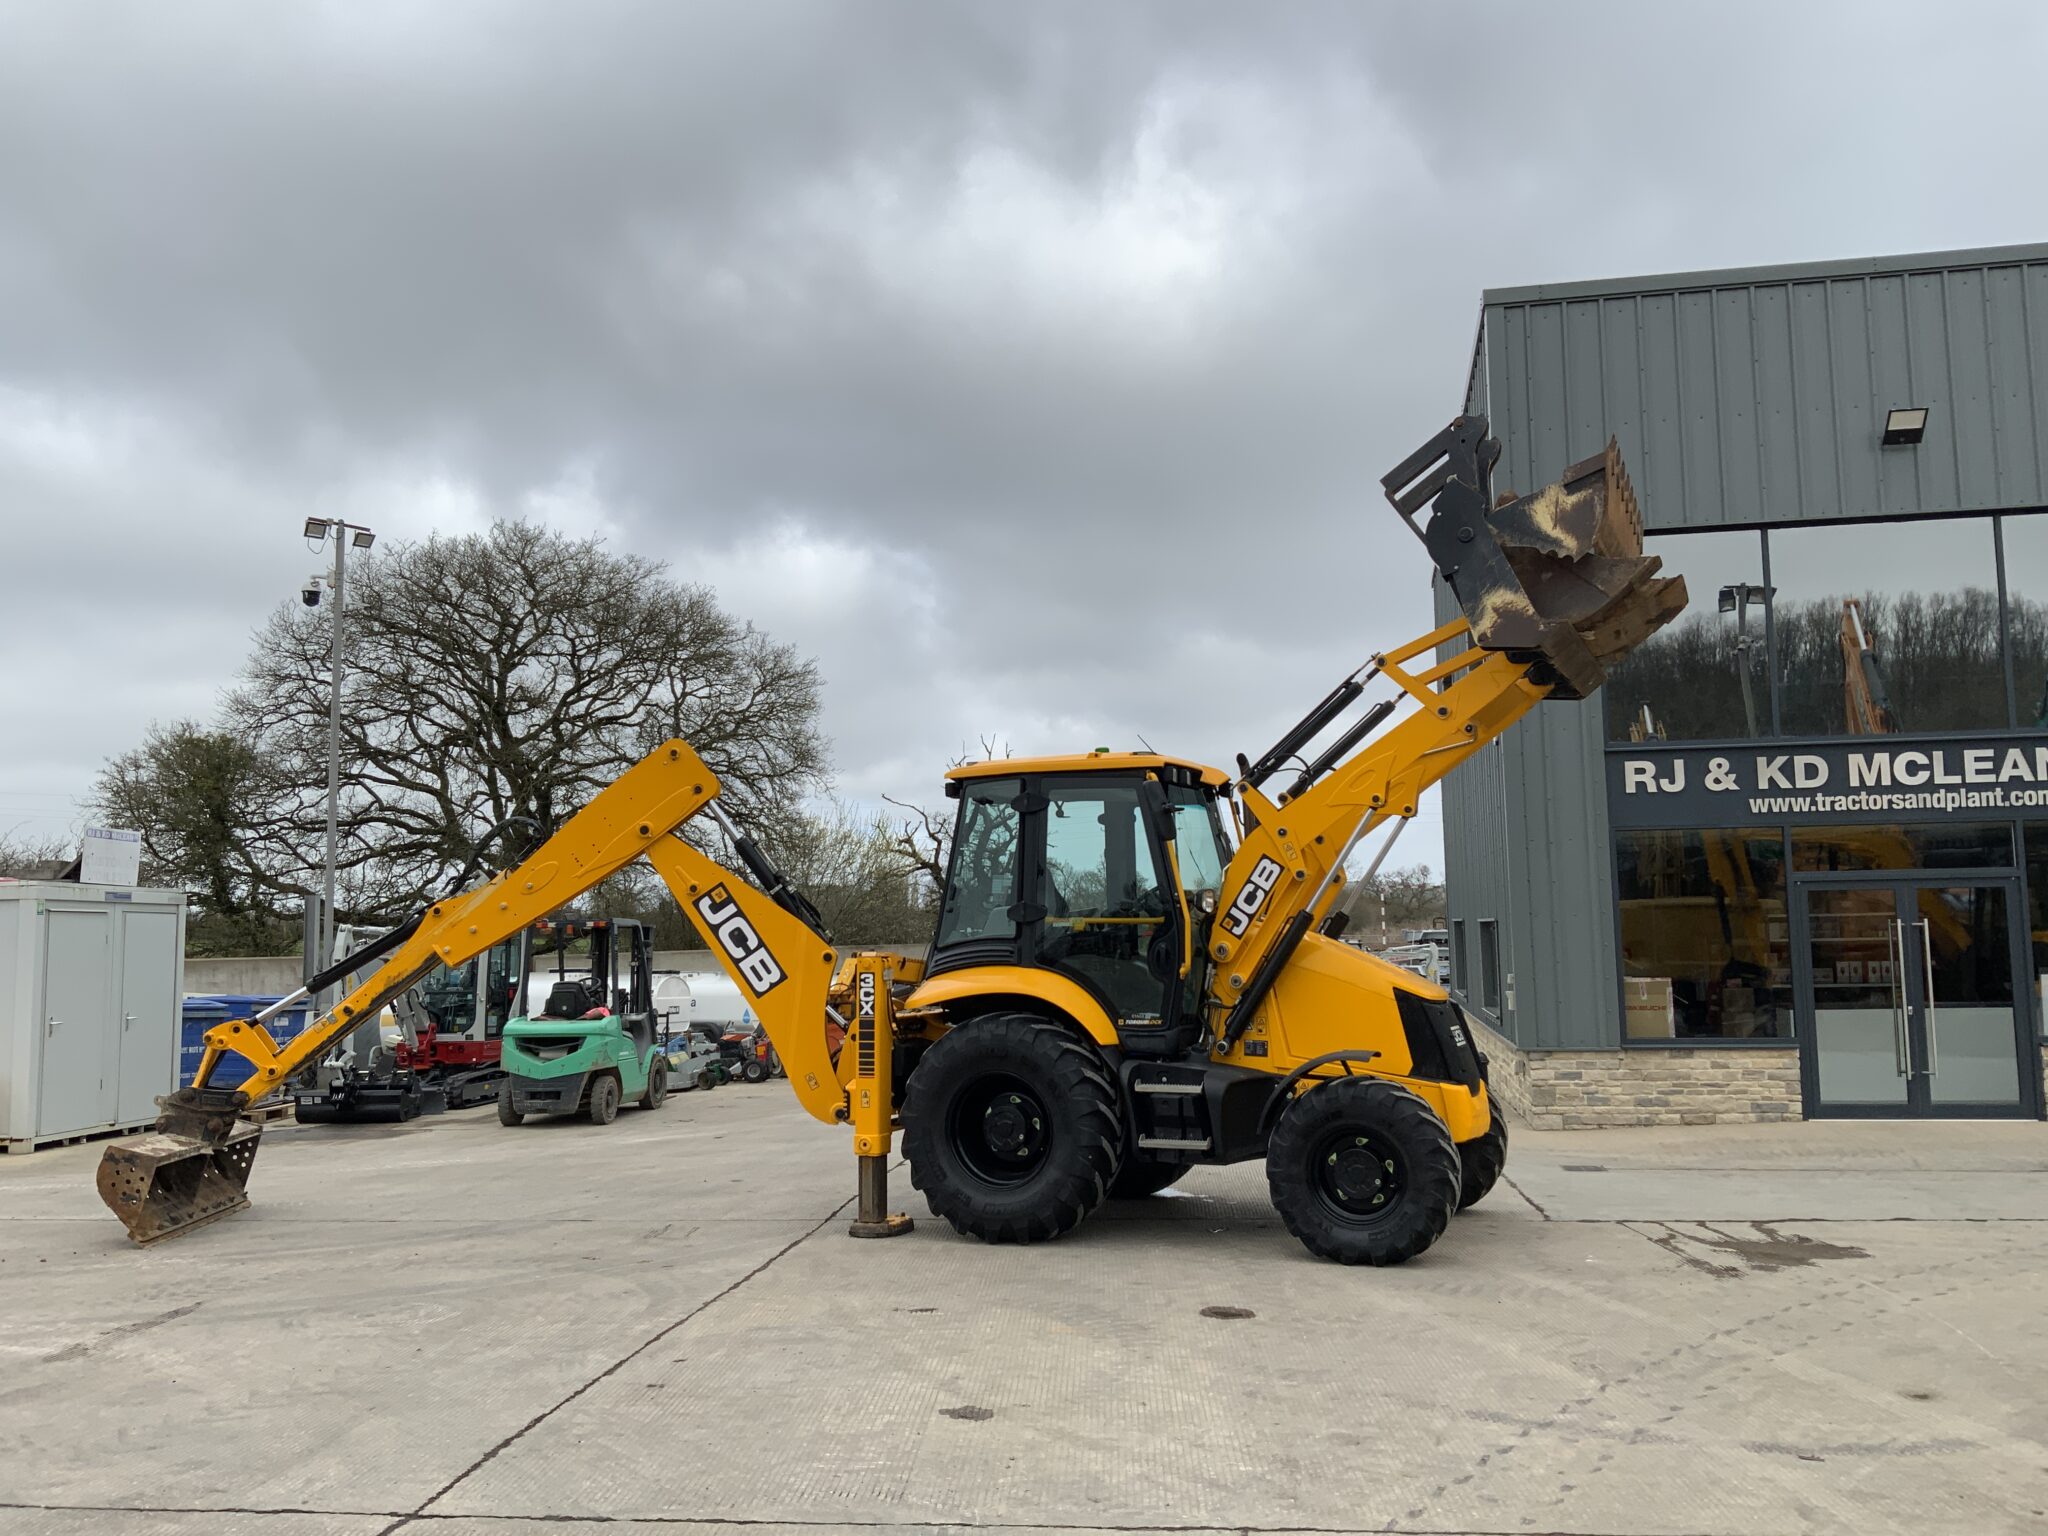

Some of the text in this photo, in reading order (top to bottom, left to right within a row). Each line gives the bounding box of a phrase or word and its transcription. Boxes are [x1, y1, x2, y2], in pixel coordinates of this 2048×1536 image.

[1624, 759, 1686, 794] RJ
[1704, 757, 1740, 791] &
[1756, 755, 1829, 789] KD
[1229, 858, 1281, 936] JCB
[698, 895, 781, 993] JCB
[860, 973, 875, 1015] 3CX
